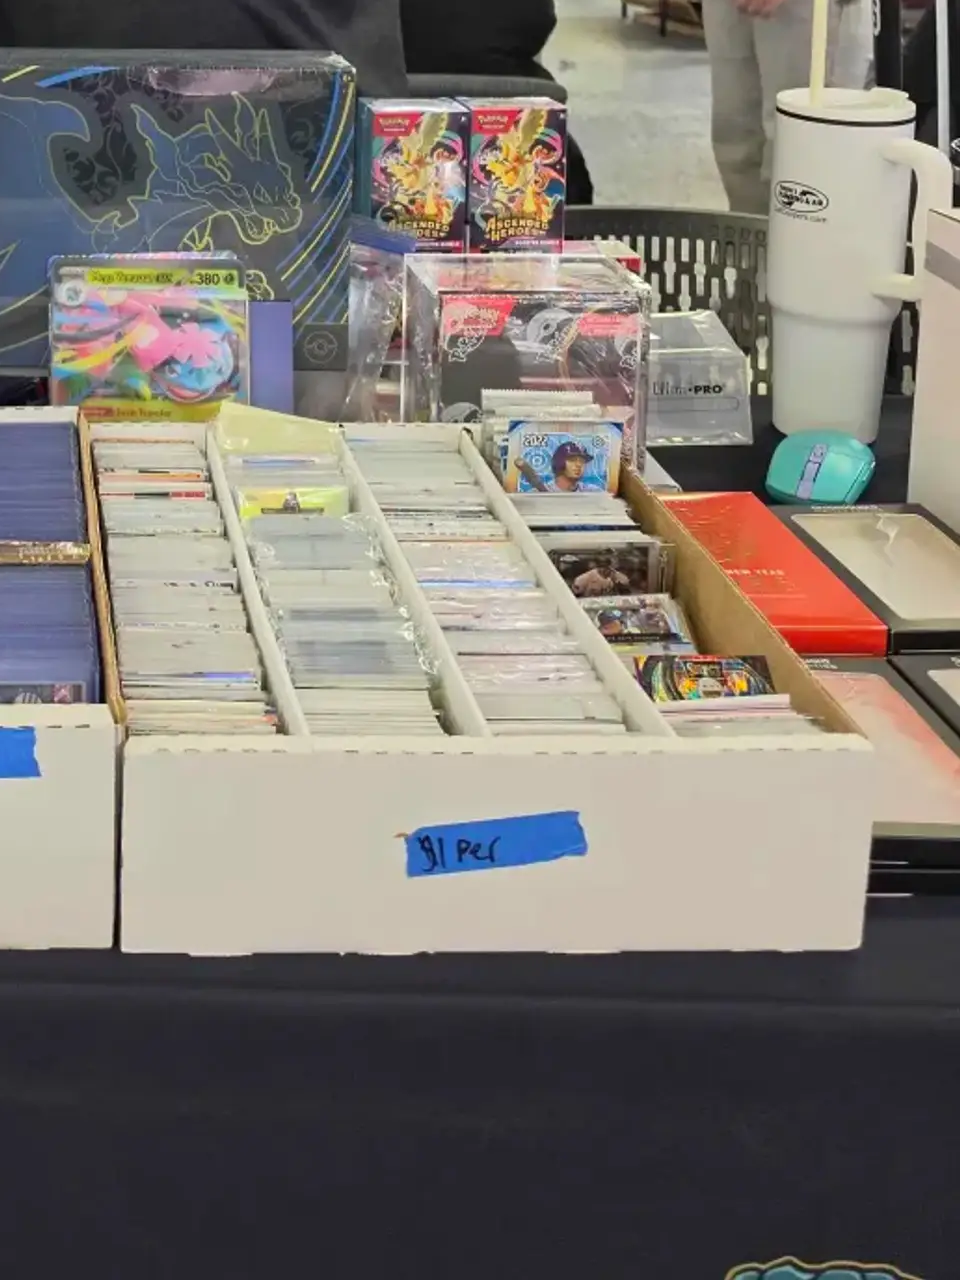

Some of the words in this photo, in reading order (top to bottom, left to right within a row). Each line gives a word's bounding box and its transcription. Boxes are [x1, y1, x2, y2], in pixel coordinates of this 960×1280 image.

[486, 217, 550, 235] ASCENDED
[489, 228, 545, 241] HEROES
[197, 272, 221, 287] 380
[523, 433, 549, 448] 2022
